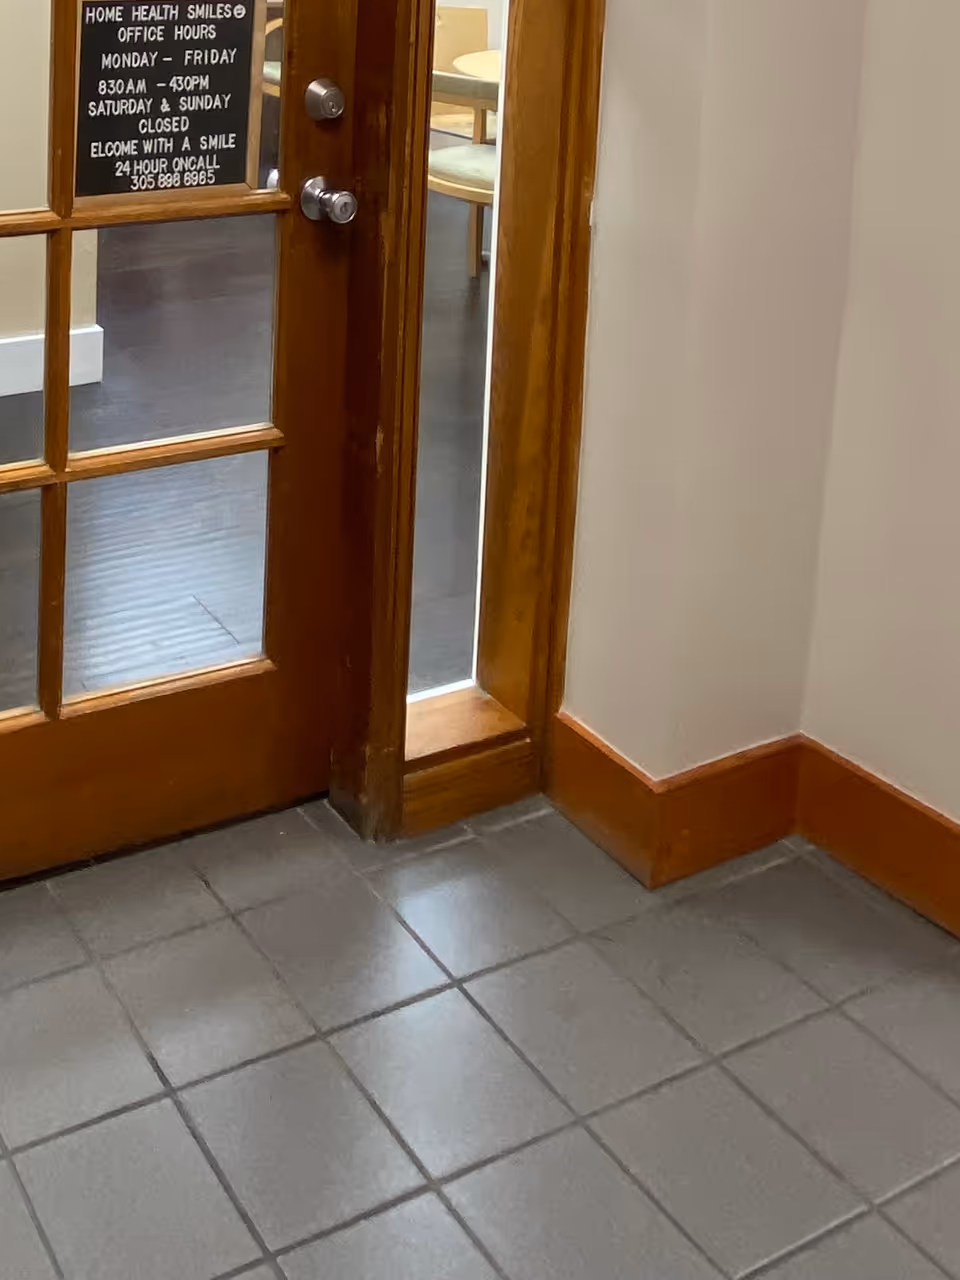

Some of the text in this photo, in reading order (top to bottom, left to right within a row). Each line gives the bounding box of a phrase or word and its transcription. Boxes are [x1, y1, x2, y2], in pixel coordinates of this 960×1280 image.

[86, 3, 232, 24] HOME HEALTH SMILES
[117, 24, 216, 43] OFFICE HOURS
[101, 51, 158, 70] MONDAY
[184, 48, 237, 66] FRIDAY
[98, 79, 147, 95] 830AM
[88, 94, 232, 117] SATURDAY & SUNDAY
[139, 116, 190, 134] CLOSED
[90, 133, 237, 158] ELCOME WITH A SMILE
[115, 161, 131, 177] 24
[134, 158, 168, 175] HOUR
[130, 174, 156, 191] 305
